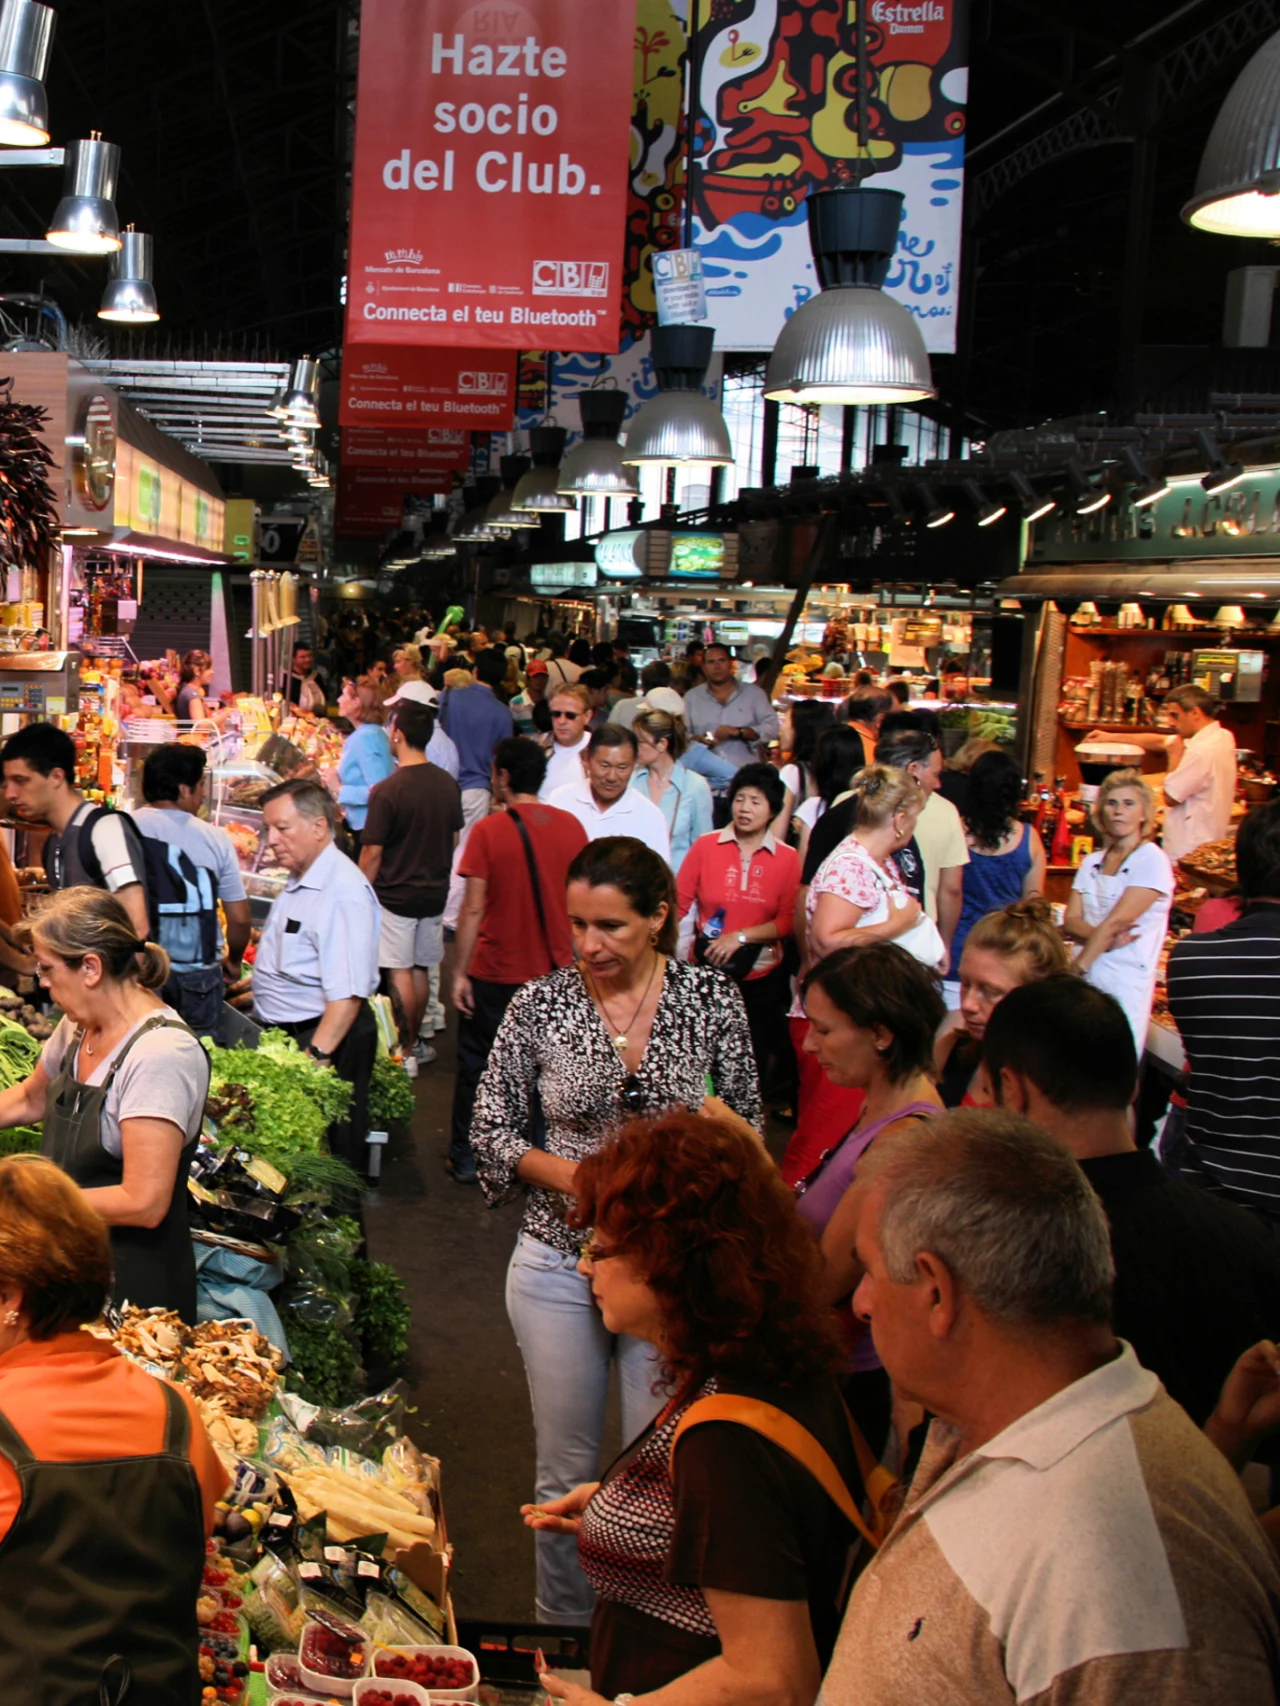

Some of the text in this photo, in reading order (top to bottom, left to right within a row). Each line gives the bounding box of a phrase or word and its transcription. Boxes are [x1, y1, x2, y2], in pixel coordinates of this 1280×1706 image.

[871, 0, 944, 22] Estrella
[431, 33, 567, 78] Hazte
[433, 93, 558, 136] socio
[382, 149, 602, 195] del Club.
[363, 302, 447, 322] Connecta
[452, 306, 469, 322] el
[475, 307, 503, 323] teu
[348, 397, 403, 411] Connecta
[406, 400, 417, 411] el
[421, 401, 439, 412] teu
